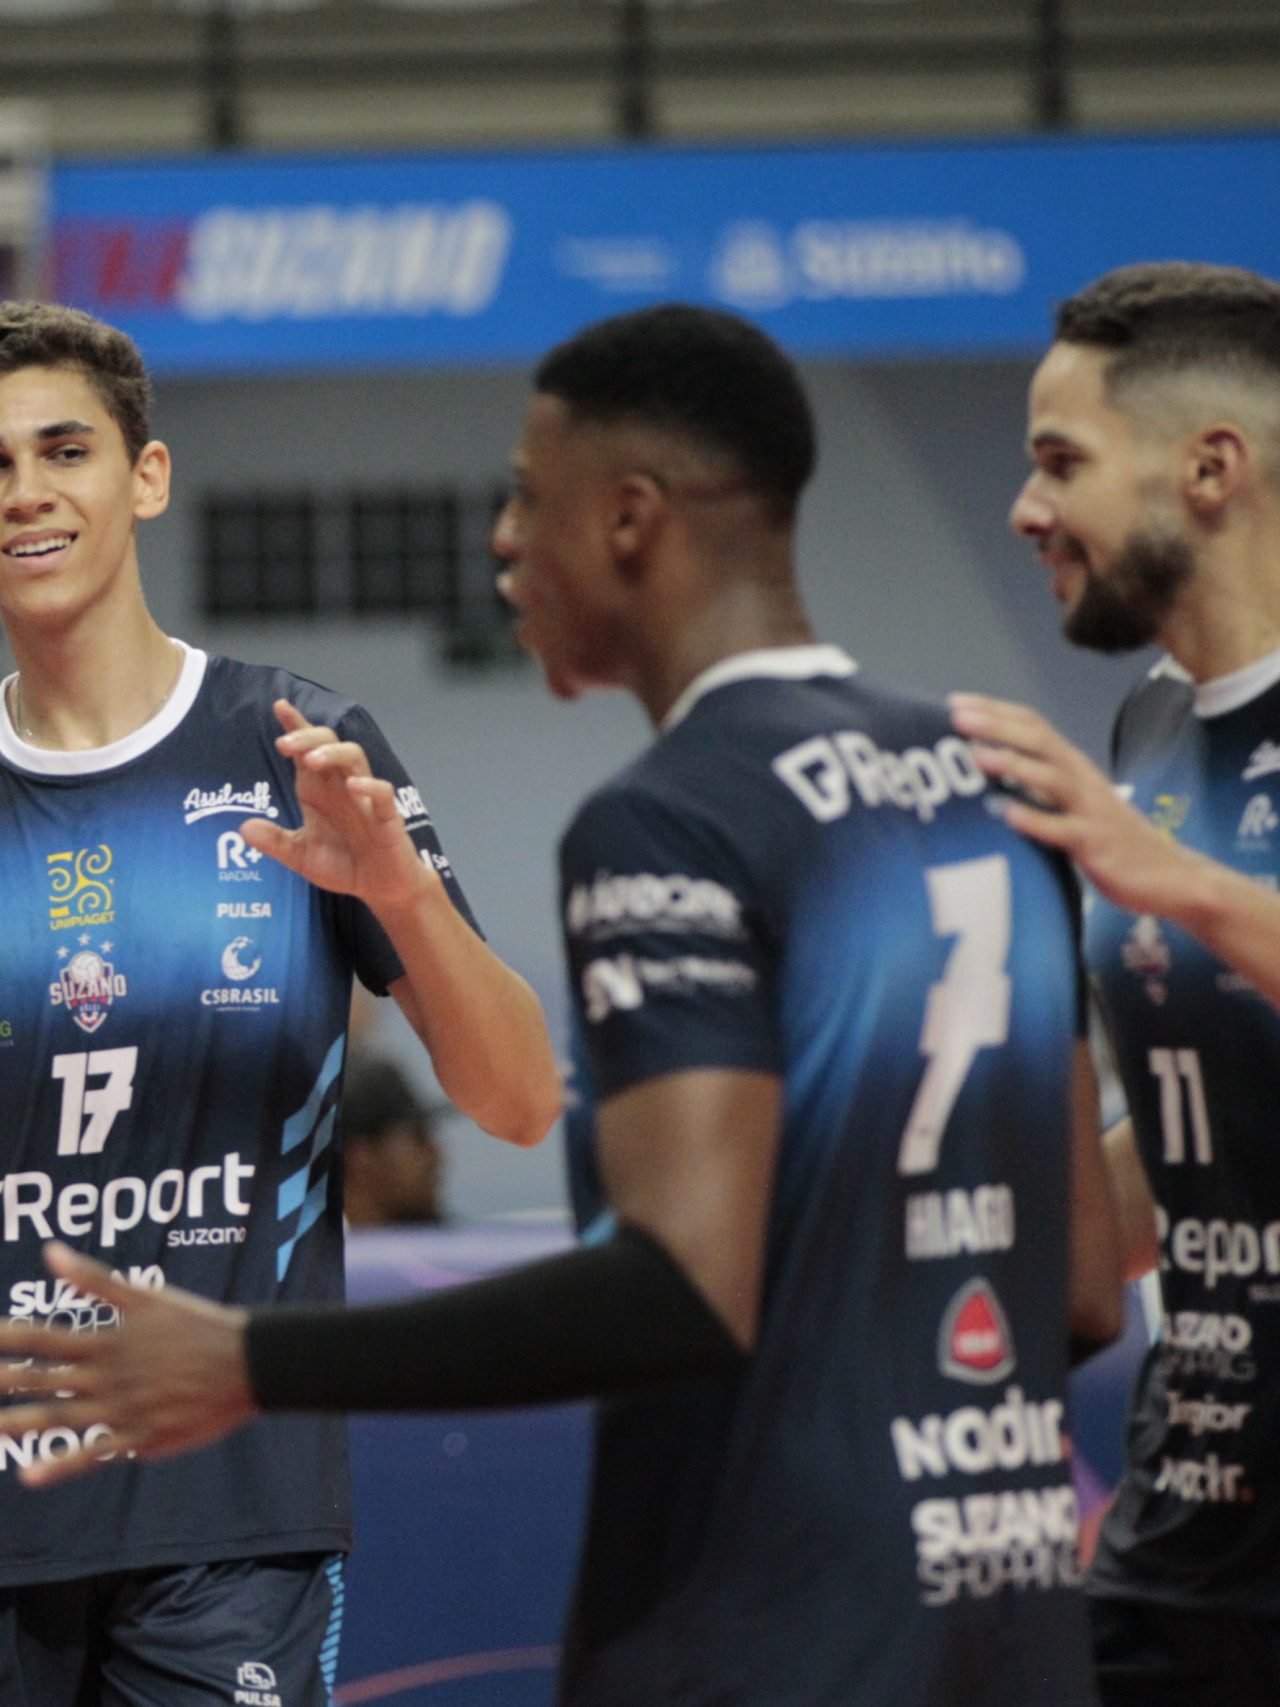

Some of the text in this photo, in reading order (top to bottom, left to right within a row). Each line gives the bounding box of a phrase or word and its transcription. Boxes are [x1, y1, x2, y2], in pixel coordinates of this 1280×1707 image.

[831, 729, 986, 822] Repo
[218, 870, 263, 882] RADIAL
[49, 911, 116, 931] UNIPIAGET
[216, 902, 273, 919] PULSA
[48, 973, 128, 1006] SUZANO
[897, 854, 1012, 1176] 7
[51, 1046, 139, 1157] 17
[1147, 1047, 1213, 1166] 11
[3, 1151, 256, 1248] Report
[167, 1226, 247, 1248] suzano
[1156, 1204, 1280, 1289] epor
[234, 1690, 282, 1707] PULSA
